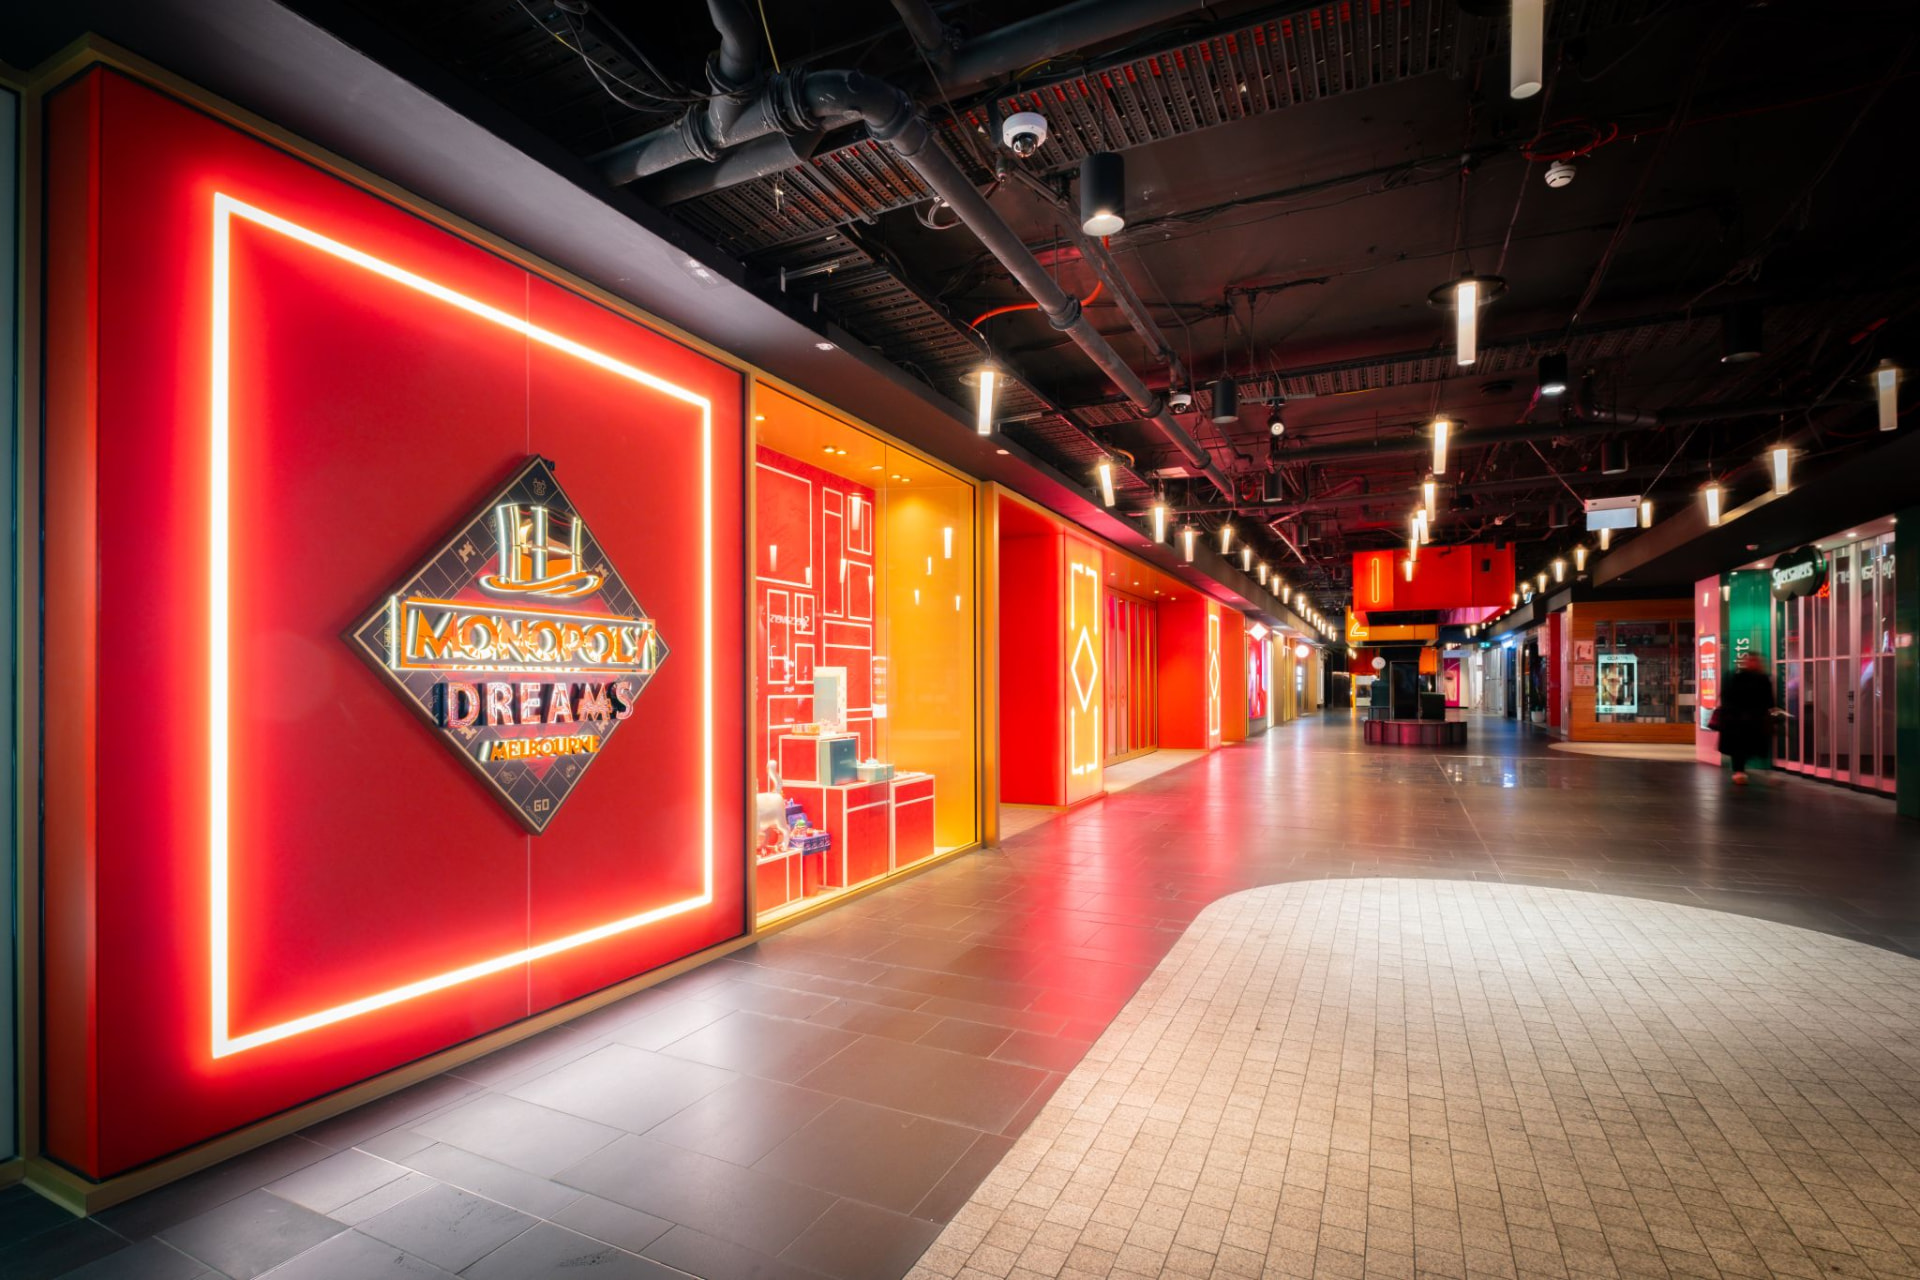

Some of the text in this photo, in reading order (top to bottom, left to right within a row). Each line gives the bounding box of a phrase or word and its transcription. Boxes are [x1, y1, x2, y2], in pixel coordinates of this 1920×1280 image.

[409, 608, 650, 664] MONOPOLY
[445, 681, 634, 729] DREAMS
[484, 735, 600, 763] MELBOURNE
[533, 798, 550, 812] GO
